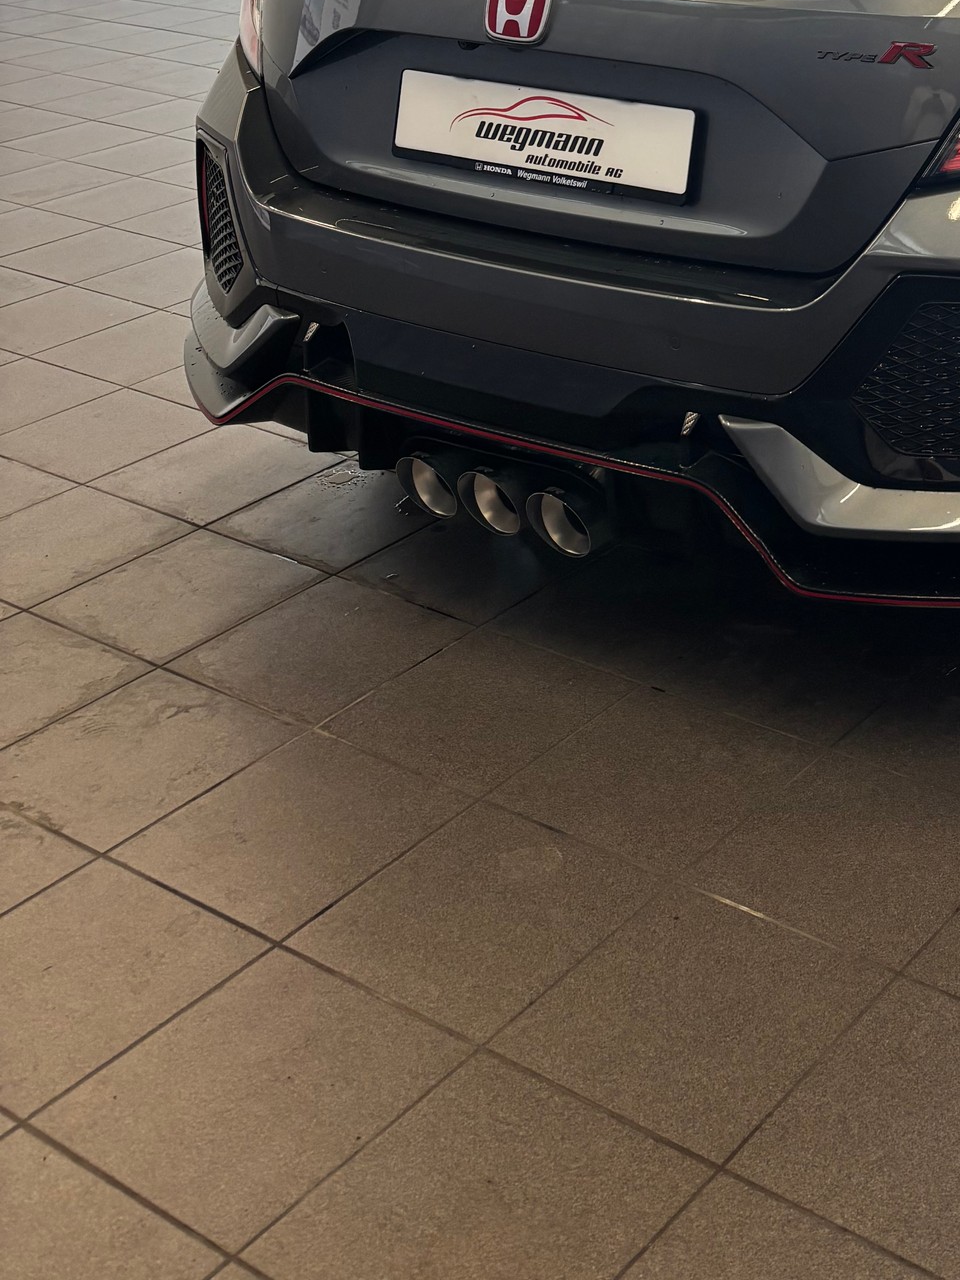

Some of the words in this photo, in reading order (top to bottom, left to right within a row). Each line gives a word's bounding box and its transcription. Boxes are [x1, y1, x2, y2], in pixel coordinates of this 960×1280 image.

[817, 50, 878, 63] TYPE
[877, 40, 937, 70] R
[475, 121, 604, 157] wegmann
[483, 165, 512, 175] HONDA
[517, 169, 551, 183] Wegmann
[552, 175, 588, 189] Volketswil
[604, 167, 624, 179] AG
